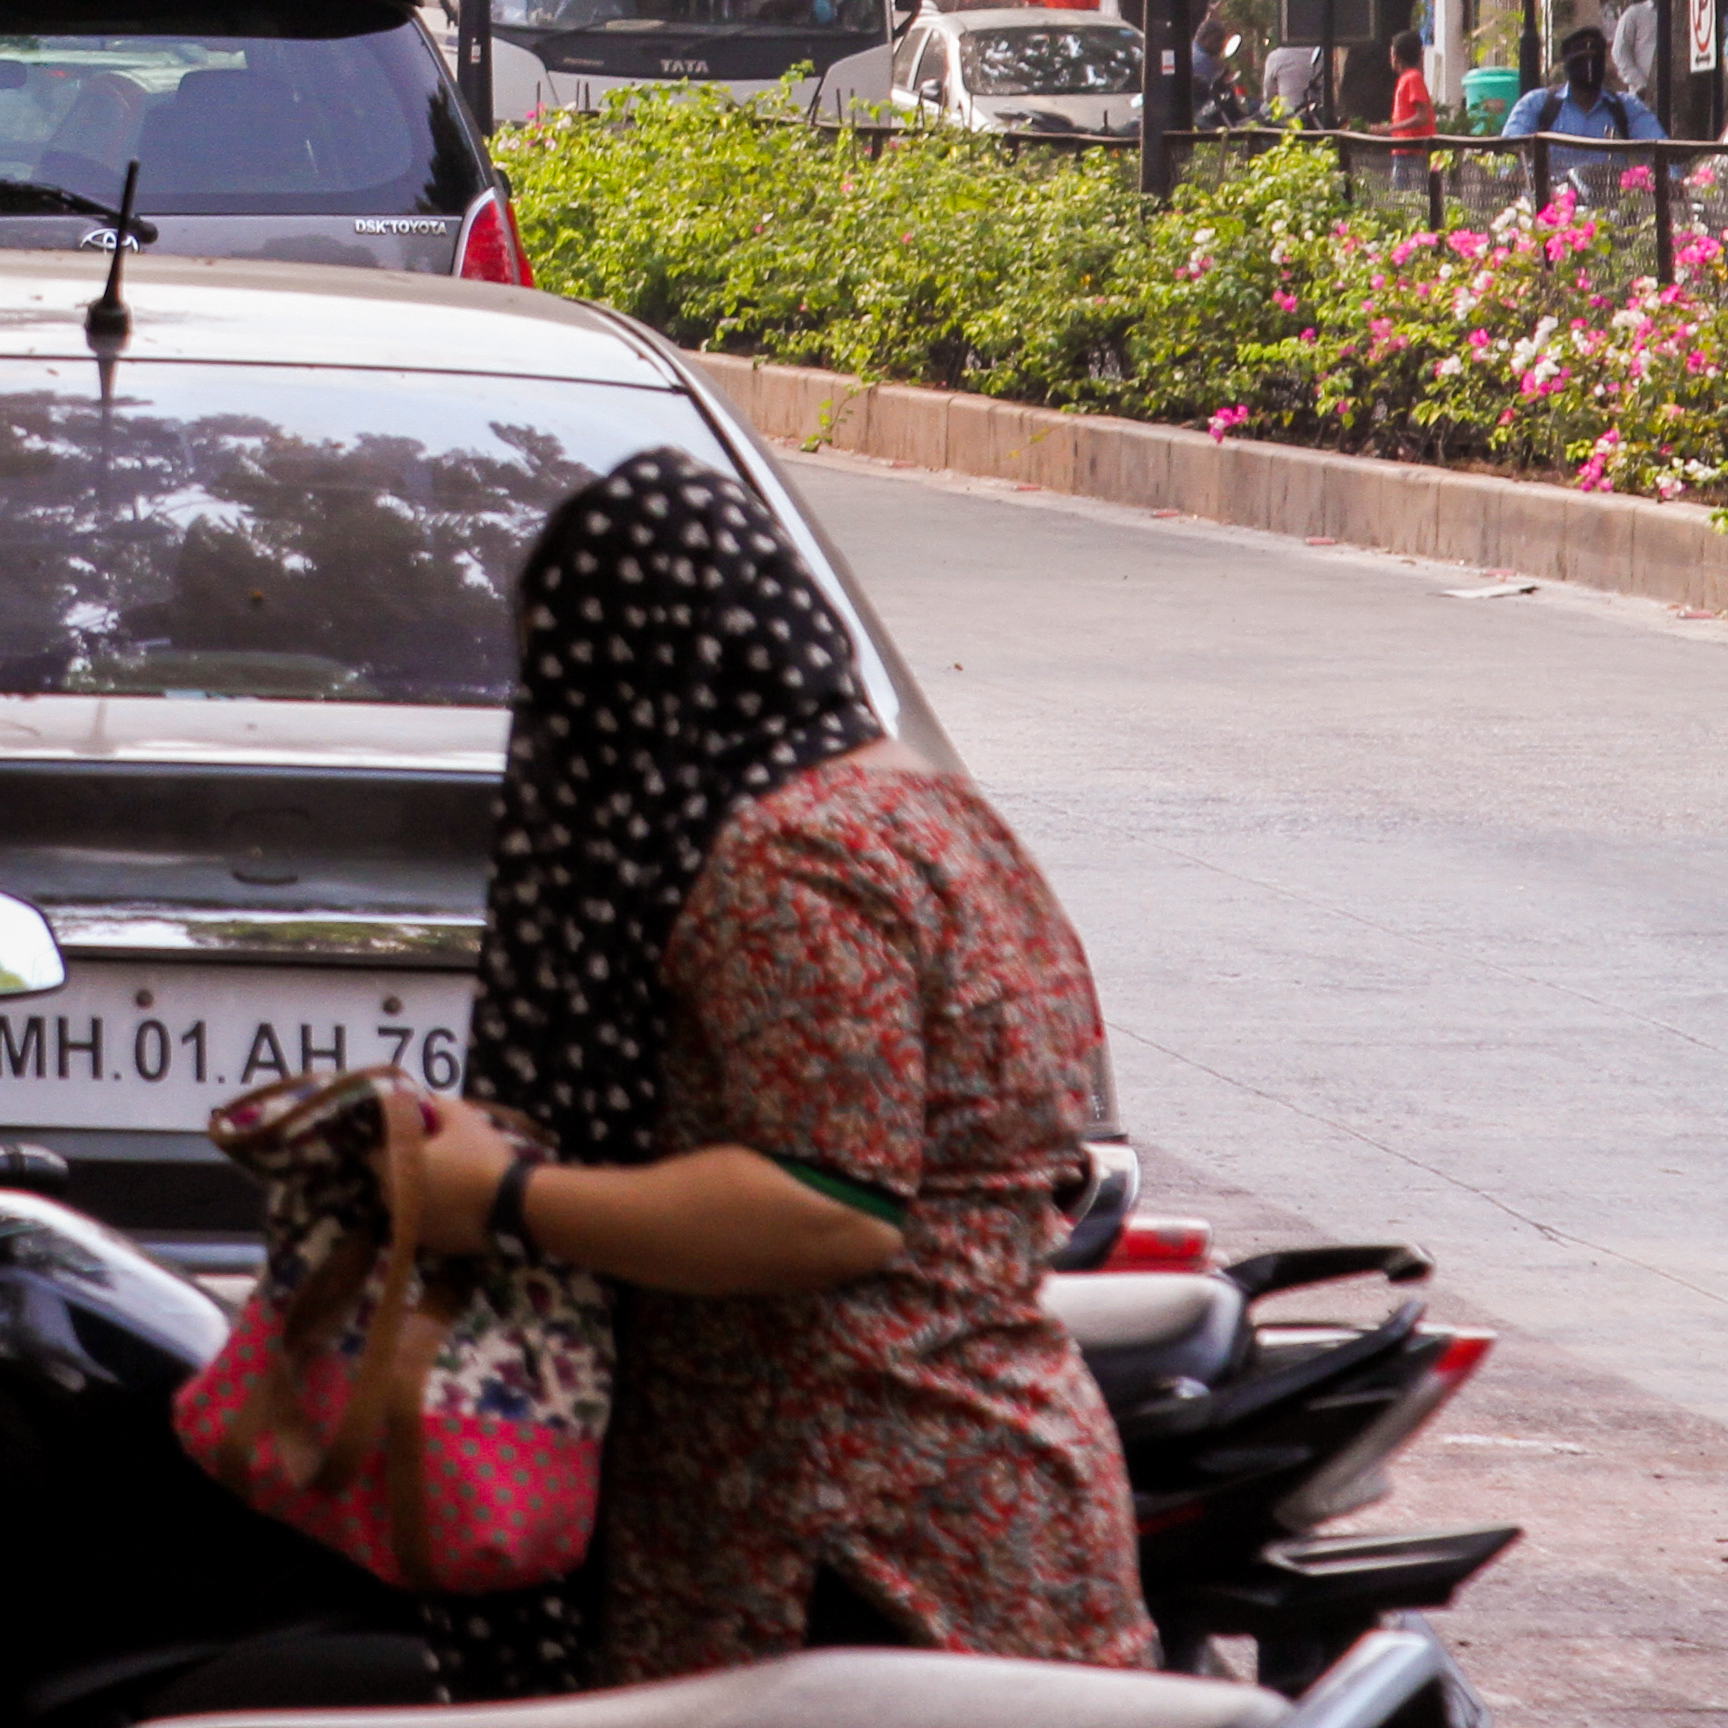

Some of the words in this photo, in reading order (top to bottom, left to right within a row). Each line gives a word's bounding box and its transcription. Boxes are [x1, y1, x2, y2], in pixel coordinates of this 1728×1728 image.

[660, 59, 710, 73] TATA
[355, 219, 386, 234] DSK
[390, 220, 447, 235] TOYOTA
